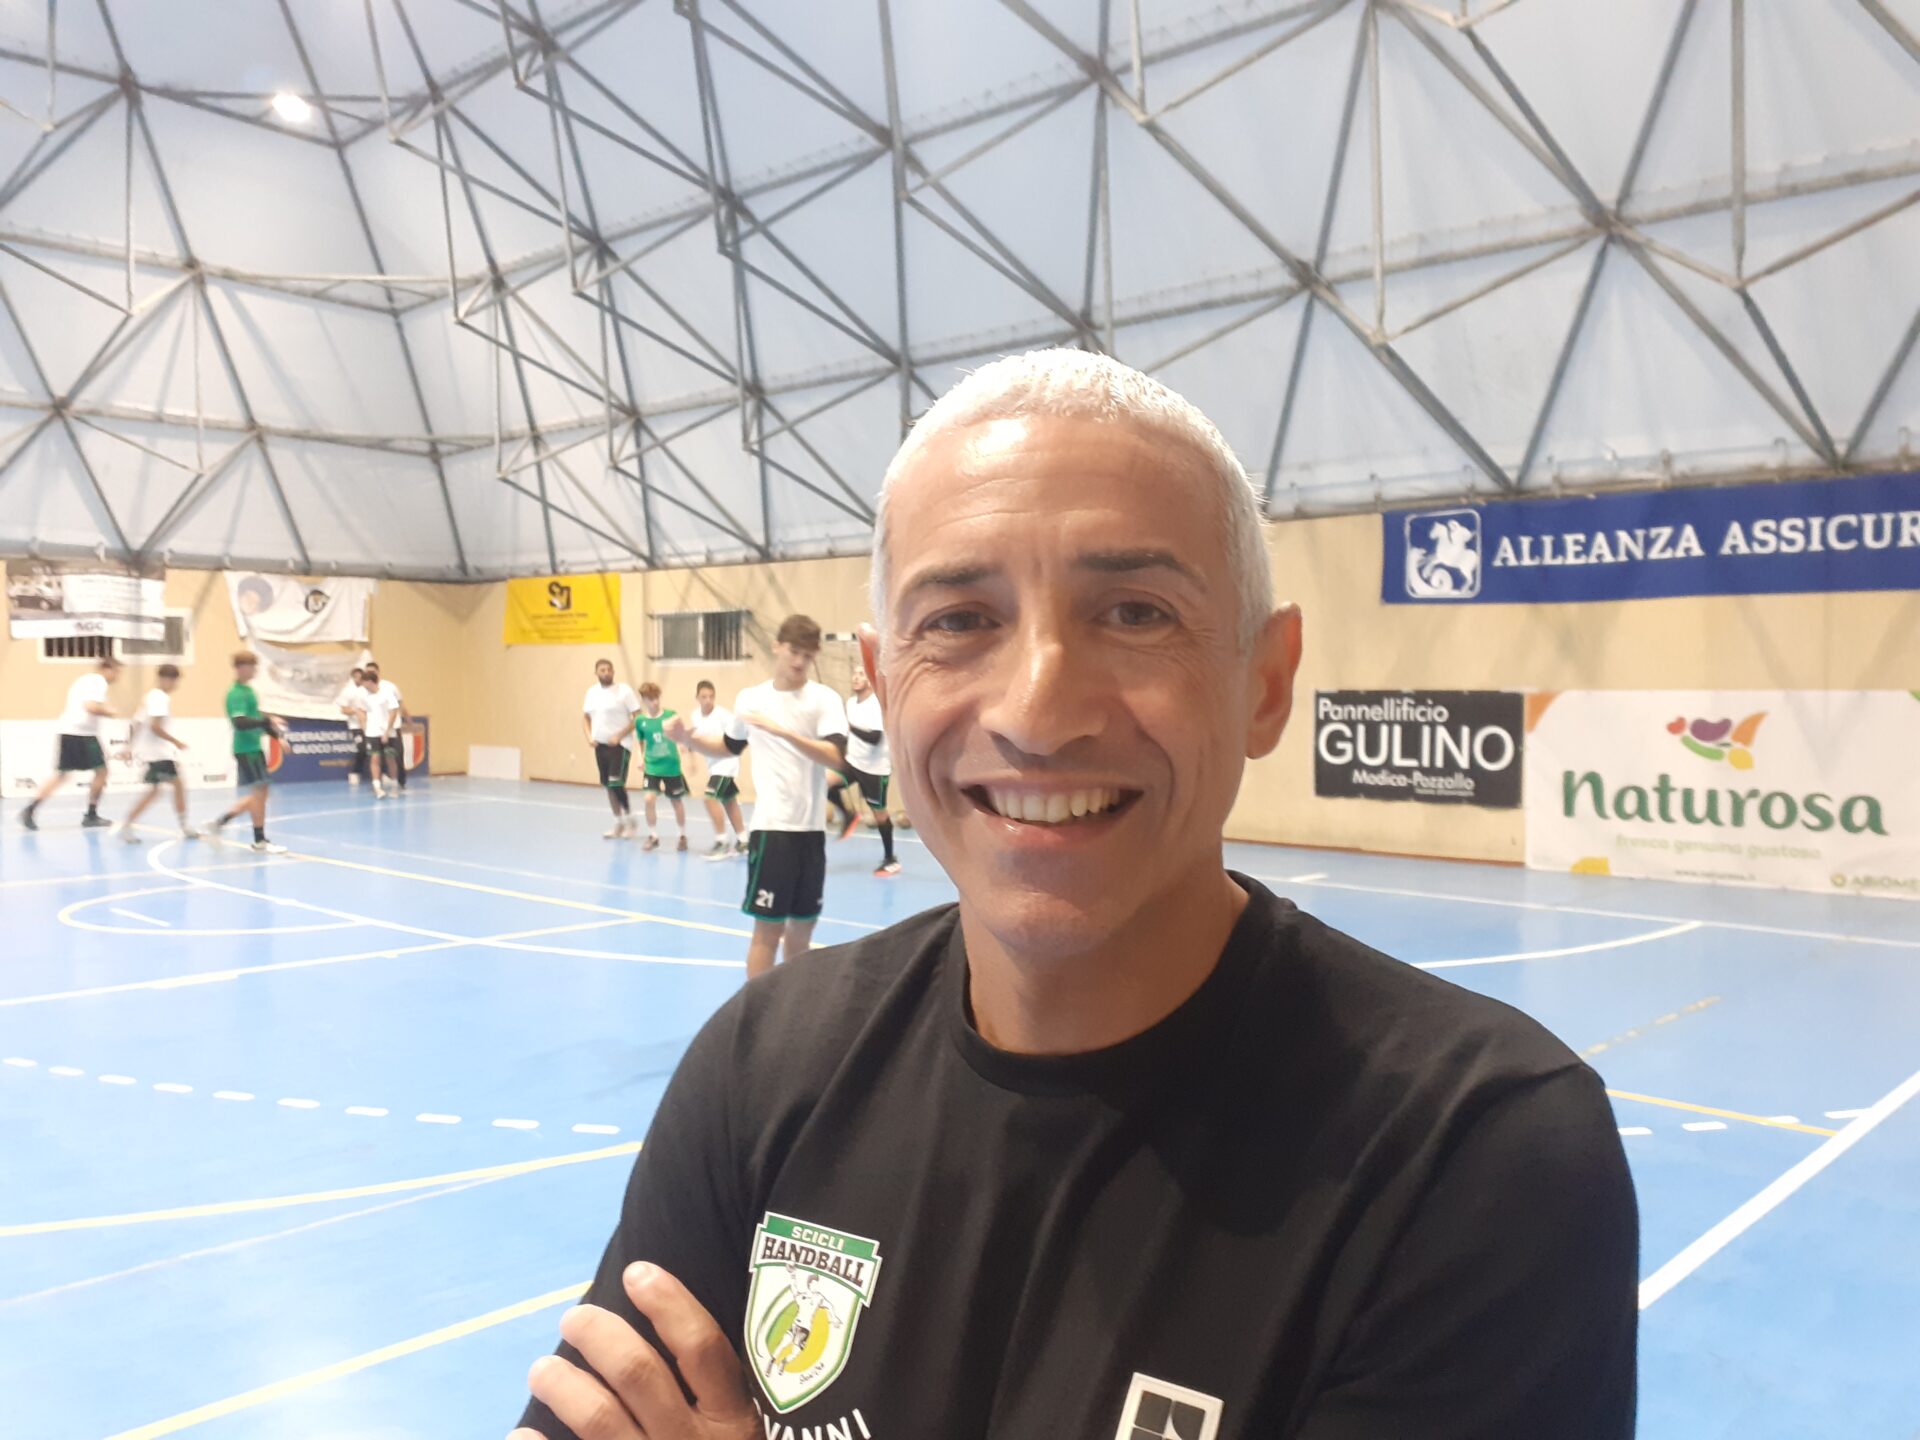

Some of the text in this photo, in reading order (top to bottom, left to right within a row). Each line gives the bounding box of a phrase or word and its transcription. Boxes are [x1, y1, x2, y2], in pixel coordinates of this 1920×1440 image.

[1492, 510, 1920, 567] ALLEANZA ASSICUR
[1318, 697, 1449, 722] Pannellificio
[1318, 722, 1515, 771] GULINO
[755, 889, 774, 908] 21
[791, 1226, 845, 1251] SCICLI
[762, 1236, 865, 1288] HANDBALL
